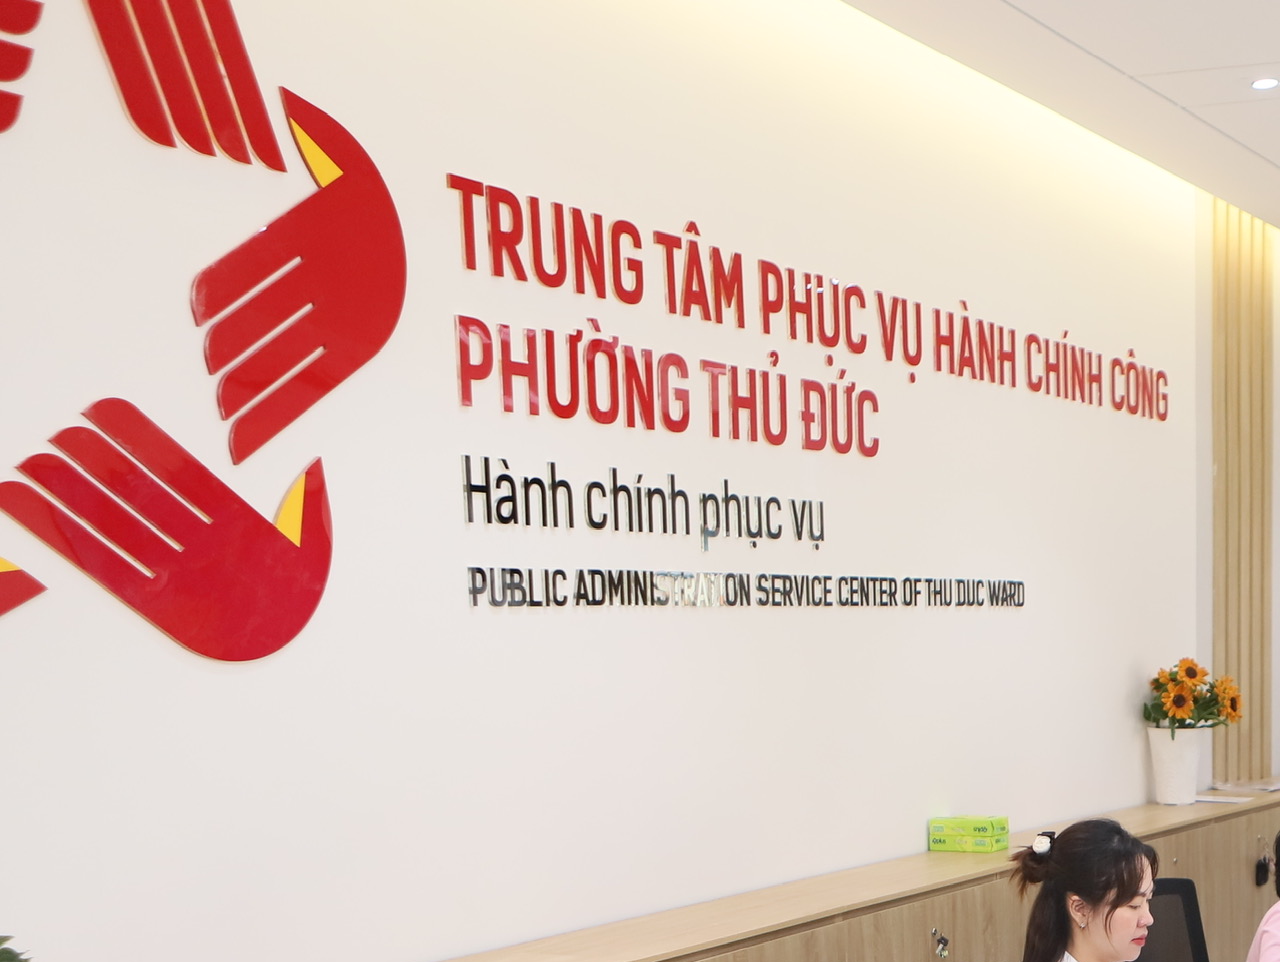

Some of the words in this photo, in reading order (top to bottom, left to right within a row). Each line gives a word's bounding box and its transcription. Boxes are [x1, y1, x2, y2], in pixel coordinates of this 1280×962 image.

[446, 172, 644, 305] TRUNG
[653, 220, 745, 329] TÂM
[757, 258, 868, 367] PHỤC
[874, 289, 923, 384] VỤ
[932, 299, 1017, 388] HÀNH
[1024, 329, 1103, 407] CHÍNH
[1110, 348, 1169, 422] CÔNG
[454, 314, 690, 433] PHƯỜNG
[700, 349, 788, 447] THỦ
[800, 368, 880, 457] ĐỨC
[461, 454, 575, 529] Hành
[583, 466, 691, 536] chính
[700, 478, 783, 552] phục
[789, 498, 825, 551] vụ
[467, 566, 568, 607] PUBLIC
[573, 569, 751, 607] ADMINISTRATION
[756, 572, 833, 607] SERVICE
[836, 575, 898, 608] CENTER
[903, 576, 922, 608] OF
[925, 577, 952, 608] THU
[955, 578, 985, 608] DUC
[988, 579, 1025, 608] WARD
